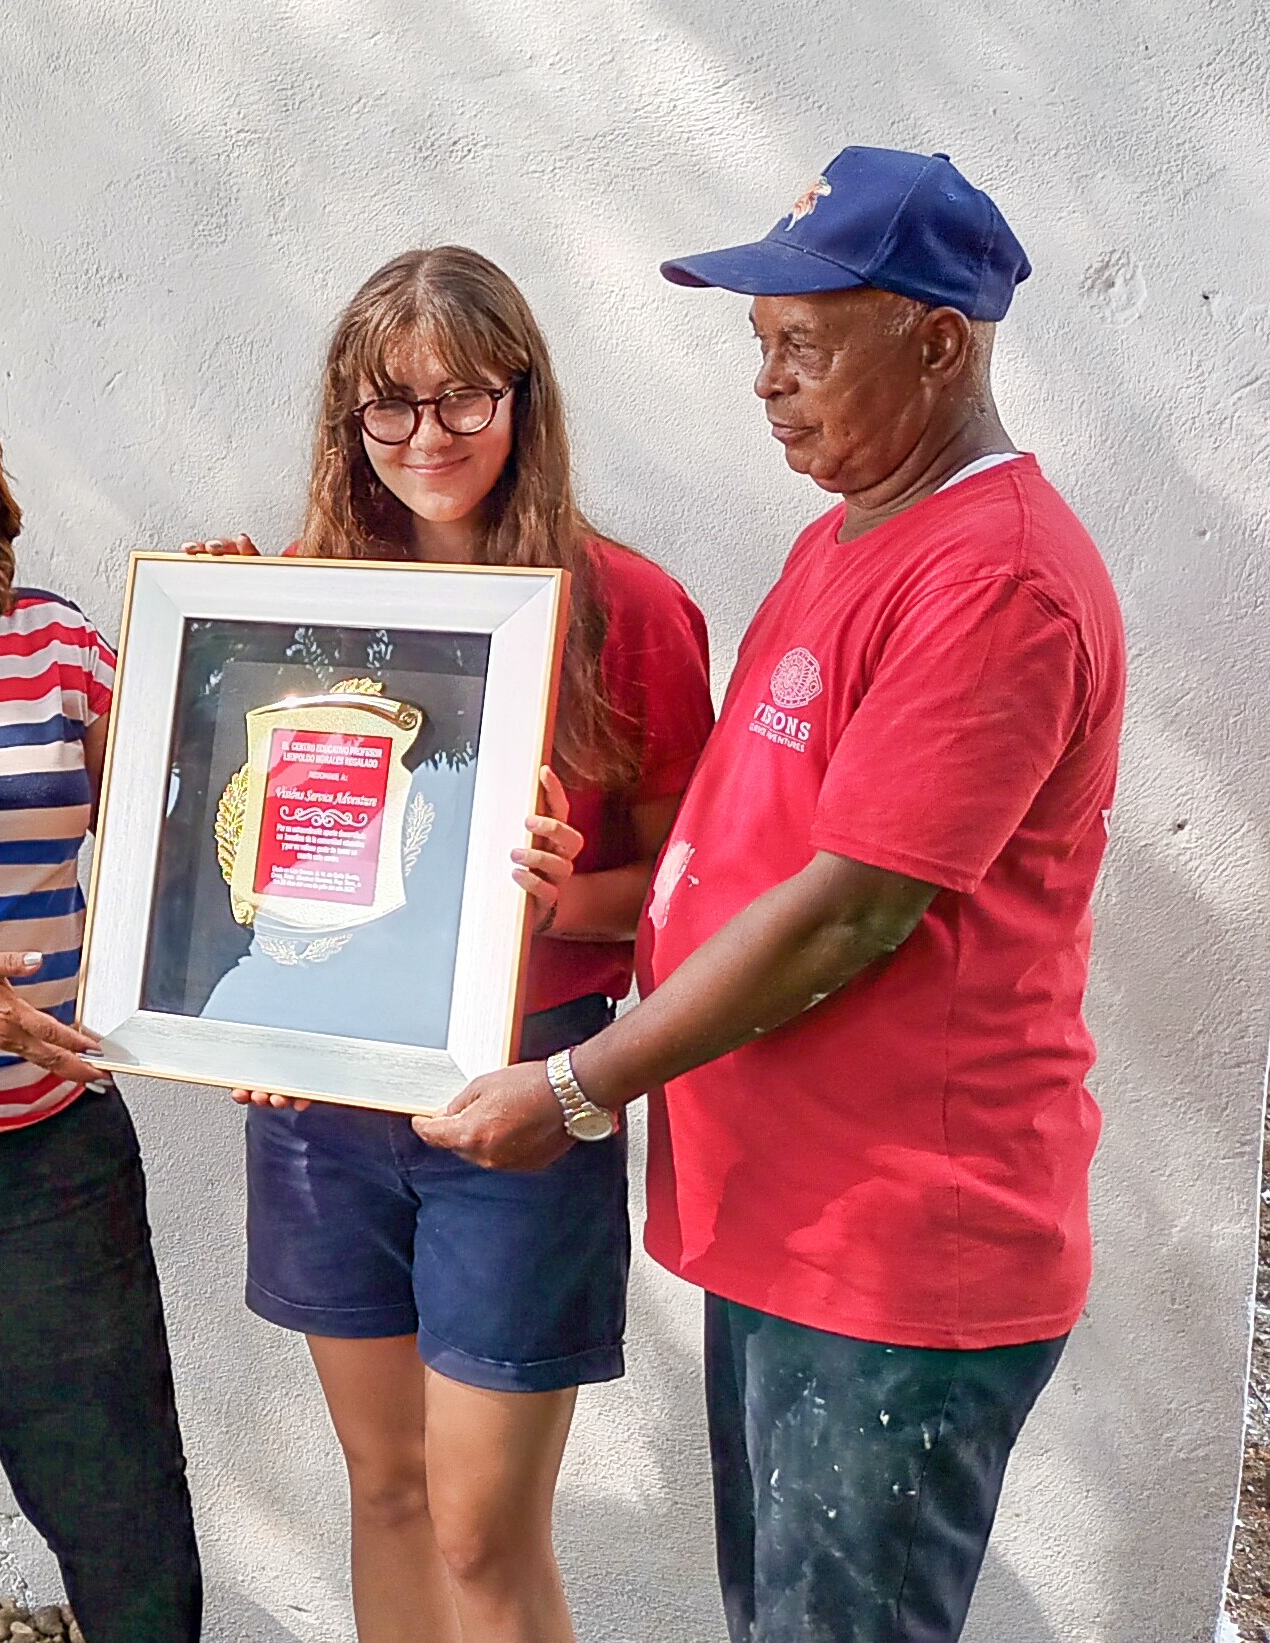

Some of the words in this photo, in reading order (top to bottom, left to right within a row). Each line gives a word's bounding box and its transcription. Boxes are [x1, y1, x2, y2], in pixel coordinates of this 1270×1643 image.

[316, 743, 349, 755] EDUCATIVO
[282, 751, 315, 763] LEOPOLDO
[315, 754, 344, 766] MORALES
[344, 757, 379, 769] REGALADO
